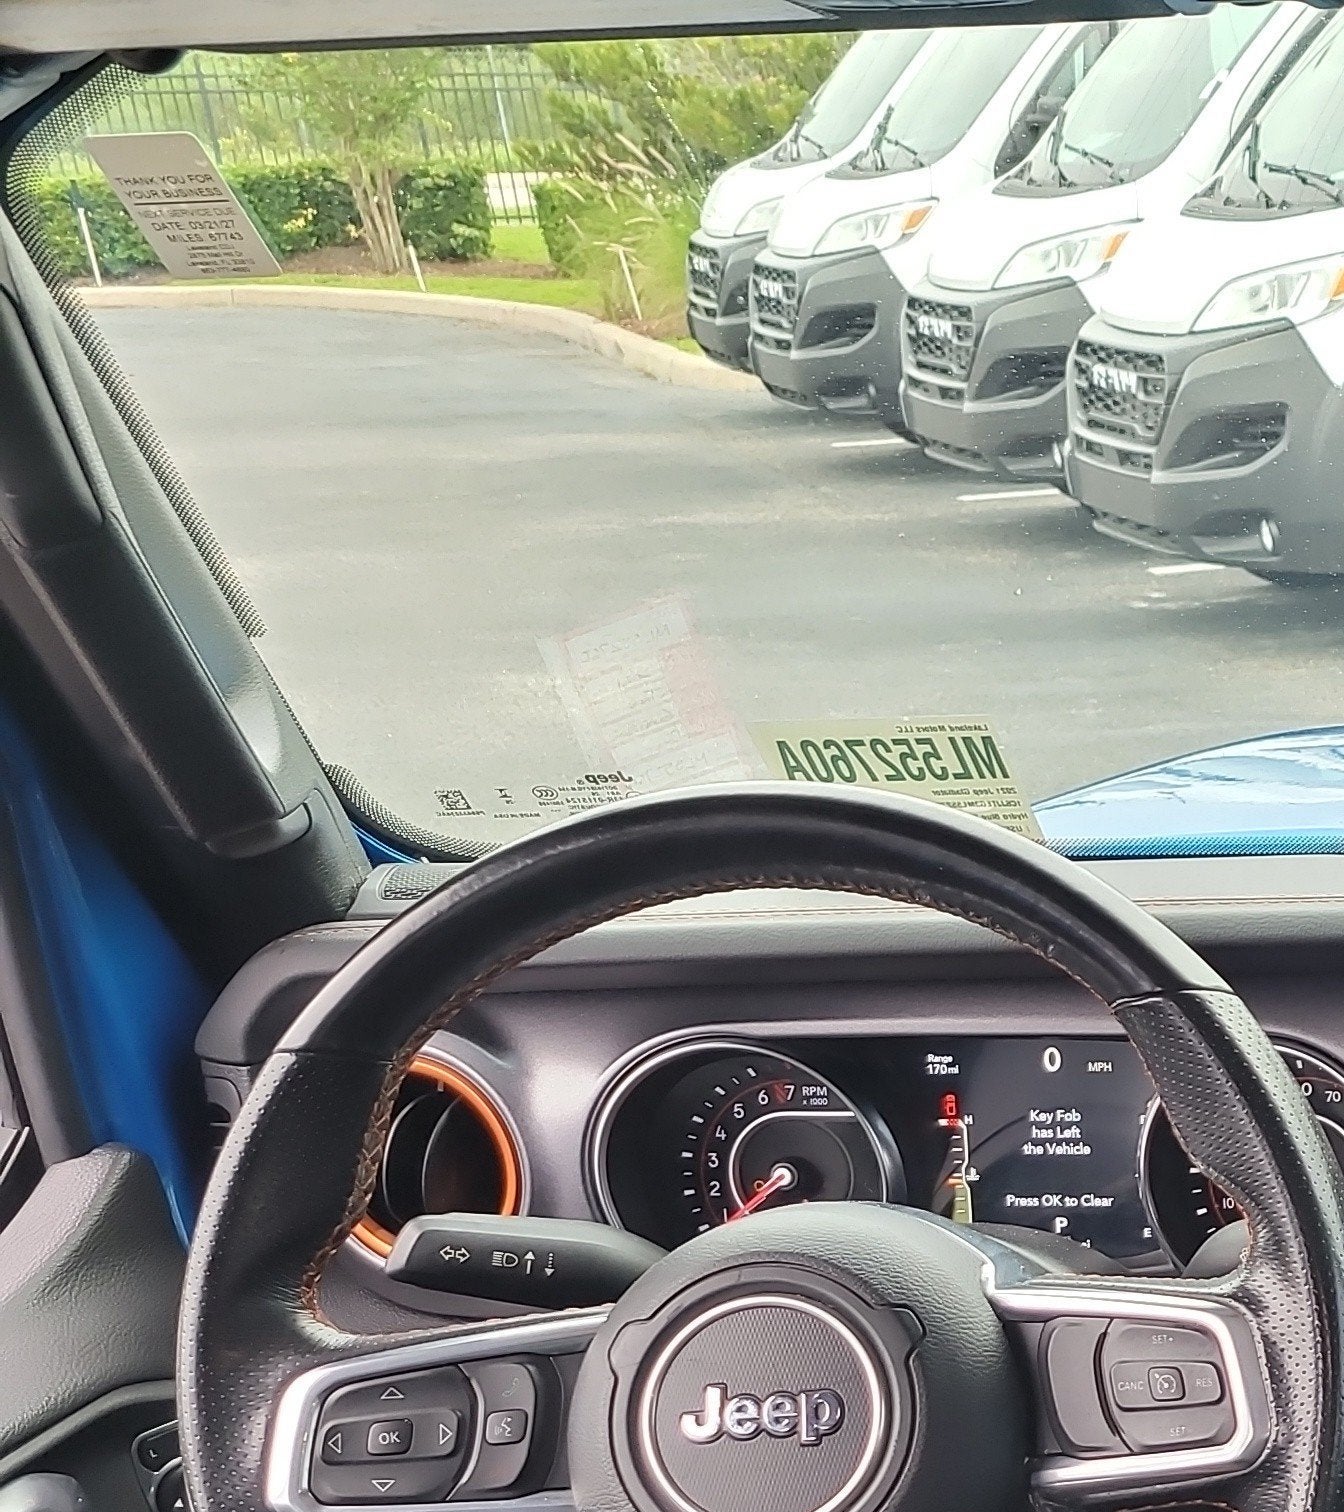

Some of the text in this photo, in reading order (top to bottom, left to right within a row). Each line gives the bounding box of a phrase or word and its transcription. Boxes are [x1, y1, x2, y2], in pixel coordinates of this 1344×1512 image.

[115, 174, 214, 186] THANK YOU FOR
[126, 187, 223, 200] YOUR BUSINESS
[138, 207, 236, 218] NEXT SERVICE DUE
[1092, 361, 1138, 395] RAM
[927, 1054, 953, 1064] Range
[1043, 1046, 1062, 1072] 0
[1088, 1062, 1113, 1072] MPH
[757, 1089, 769, 1105] 6
[784, 1085, 795, 1101] 7
[802, 1086, 828, 1097] RPM
[1325, 1090, 1342, 1103] 70
[733, 1103, 745, 1119] 5
[1030, 1109, 1082, 1123] Key Fob
[715, 1125, 727, 1140] 4
[1032, 1126, 1081, 1139] has Left
[1023, 1143, 1091, 1155] the Vehicle
[707, 1152, 719, 1168] 3
[709, 1181, 721, 1196] 2
[1006, 1194, 1114, 1207] Press OK to Clear
[1222, 1197, 1235, 1209] 10
[1054, 1217, 1069, 1234] P
[1143, 1227, 1152, 1238] E
[1118, 1381, 1144, 1391] CANC
[1196, 1378, 1213, 1388] RES
[680, 1383, 845, 1447] Jeep
[378, 1431, 401, 1445] OK
